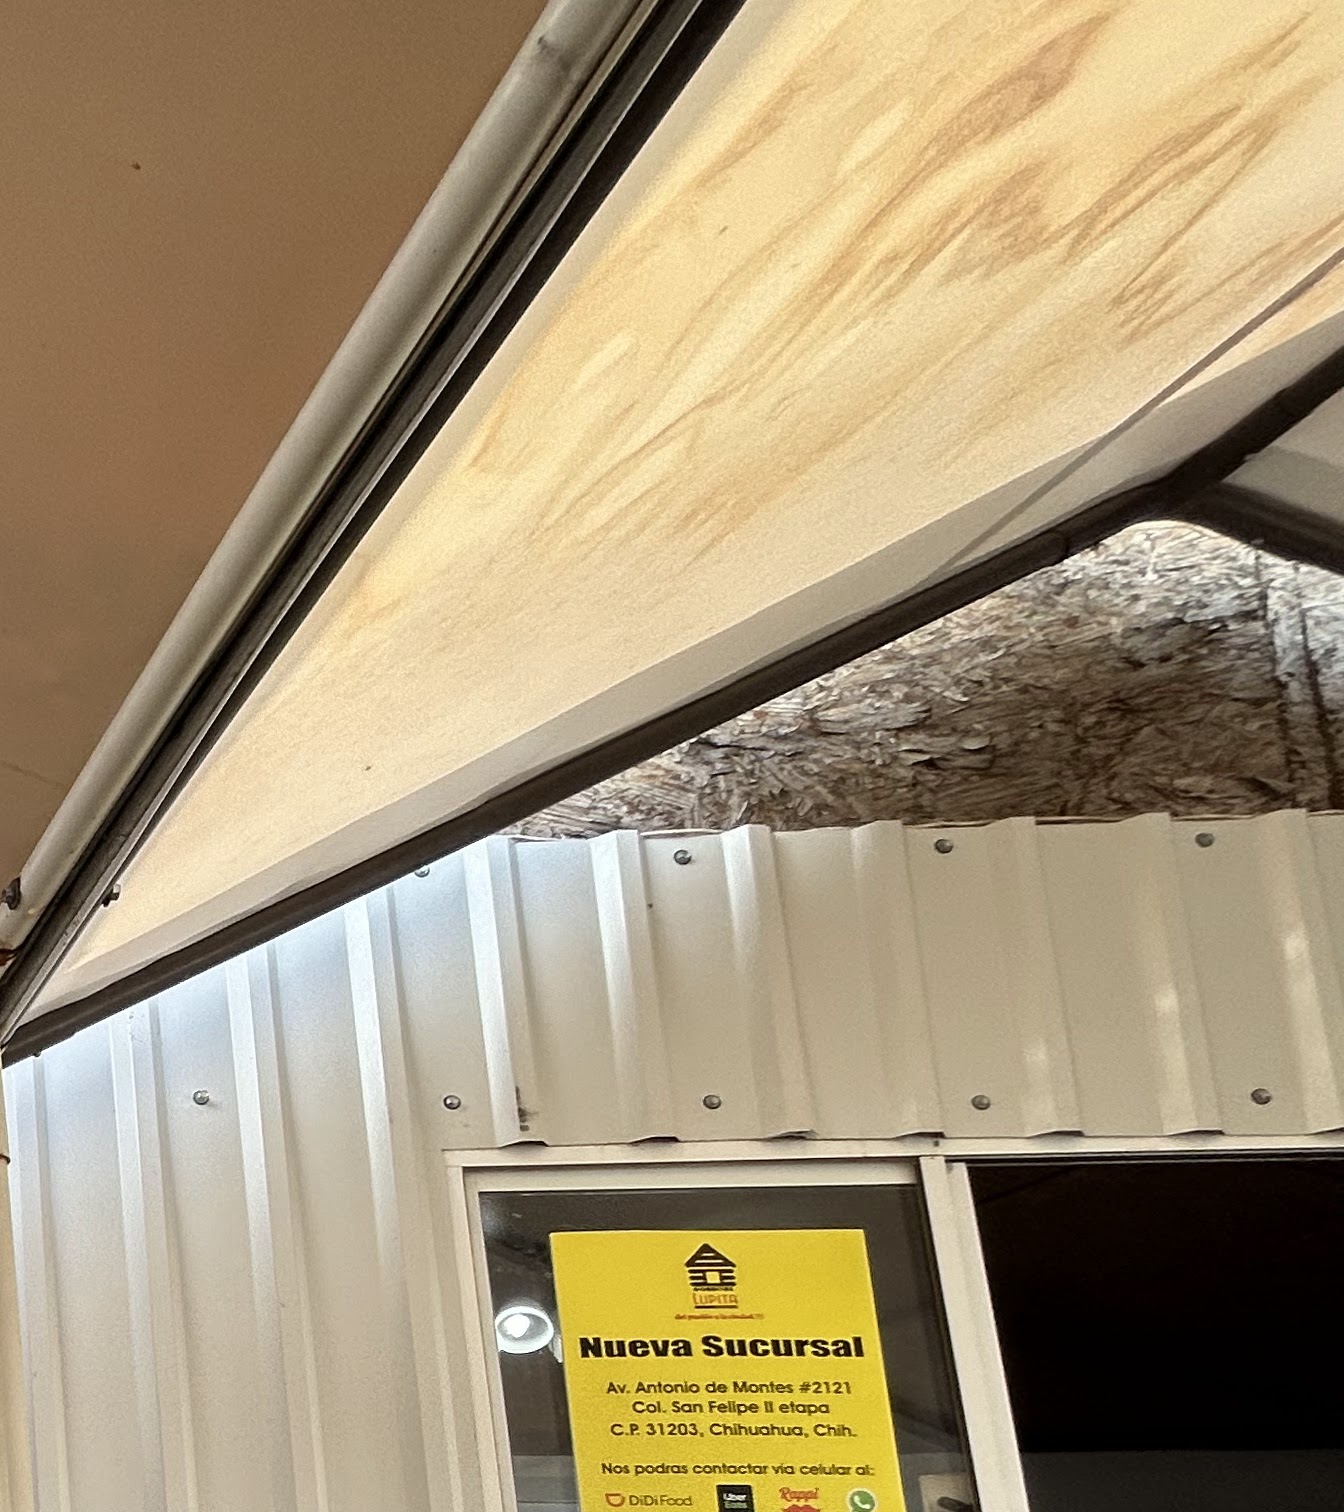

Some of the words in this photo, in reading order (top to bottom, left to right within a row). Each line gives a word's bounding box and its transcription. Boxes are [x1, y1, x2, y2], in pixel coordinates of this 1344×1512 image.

[579, 1337, 693, 1358] Nueva
[701, 1335, 864, 1358] Sucursal
[606, 1382, 630, 1394] Av.
[635, 1381, 701, 1394] Antonio
[705, 1381, 728, 1394] de
[733, 1381, 793, 1394] Montes
[798, 1382, 852, 1395] #2121
[632, 1401, 666, 1414] Col.
[672, 1401, 703, 1413] San
[708, 1401, 759, 1416] Felipe
[779, 1401, 830, 1416] etapa
[646, 1423, 705, 1438] 31203,
[709, 1423, 810, 1438] Chihuahua,
[813, 1423, 858, 1437] Chih.
[601, 1462, 630, 1474] Nos
[692, 1463, 768, 1475] contactar
[800, 1463, 851, 1475] celular
